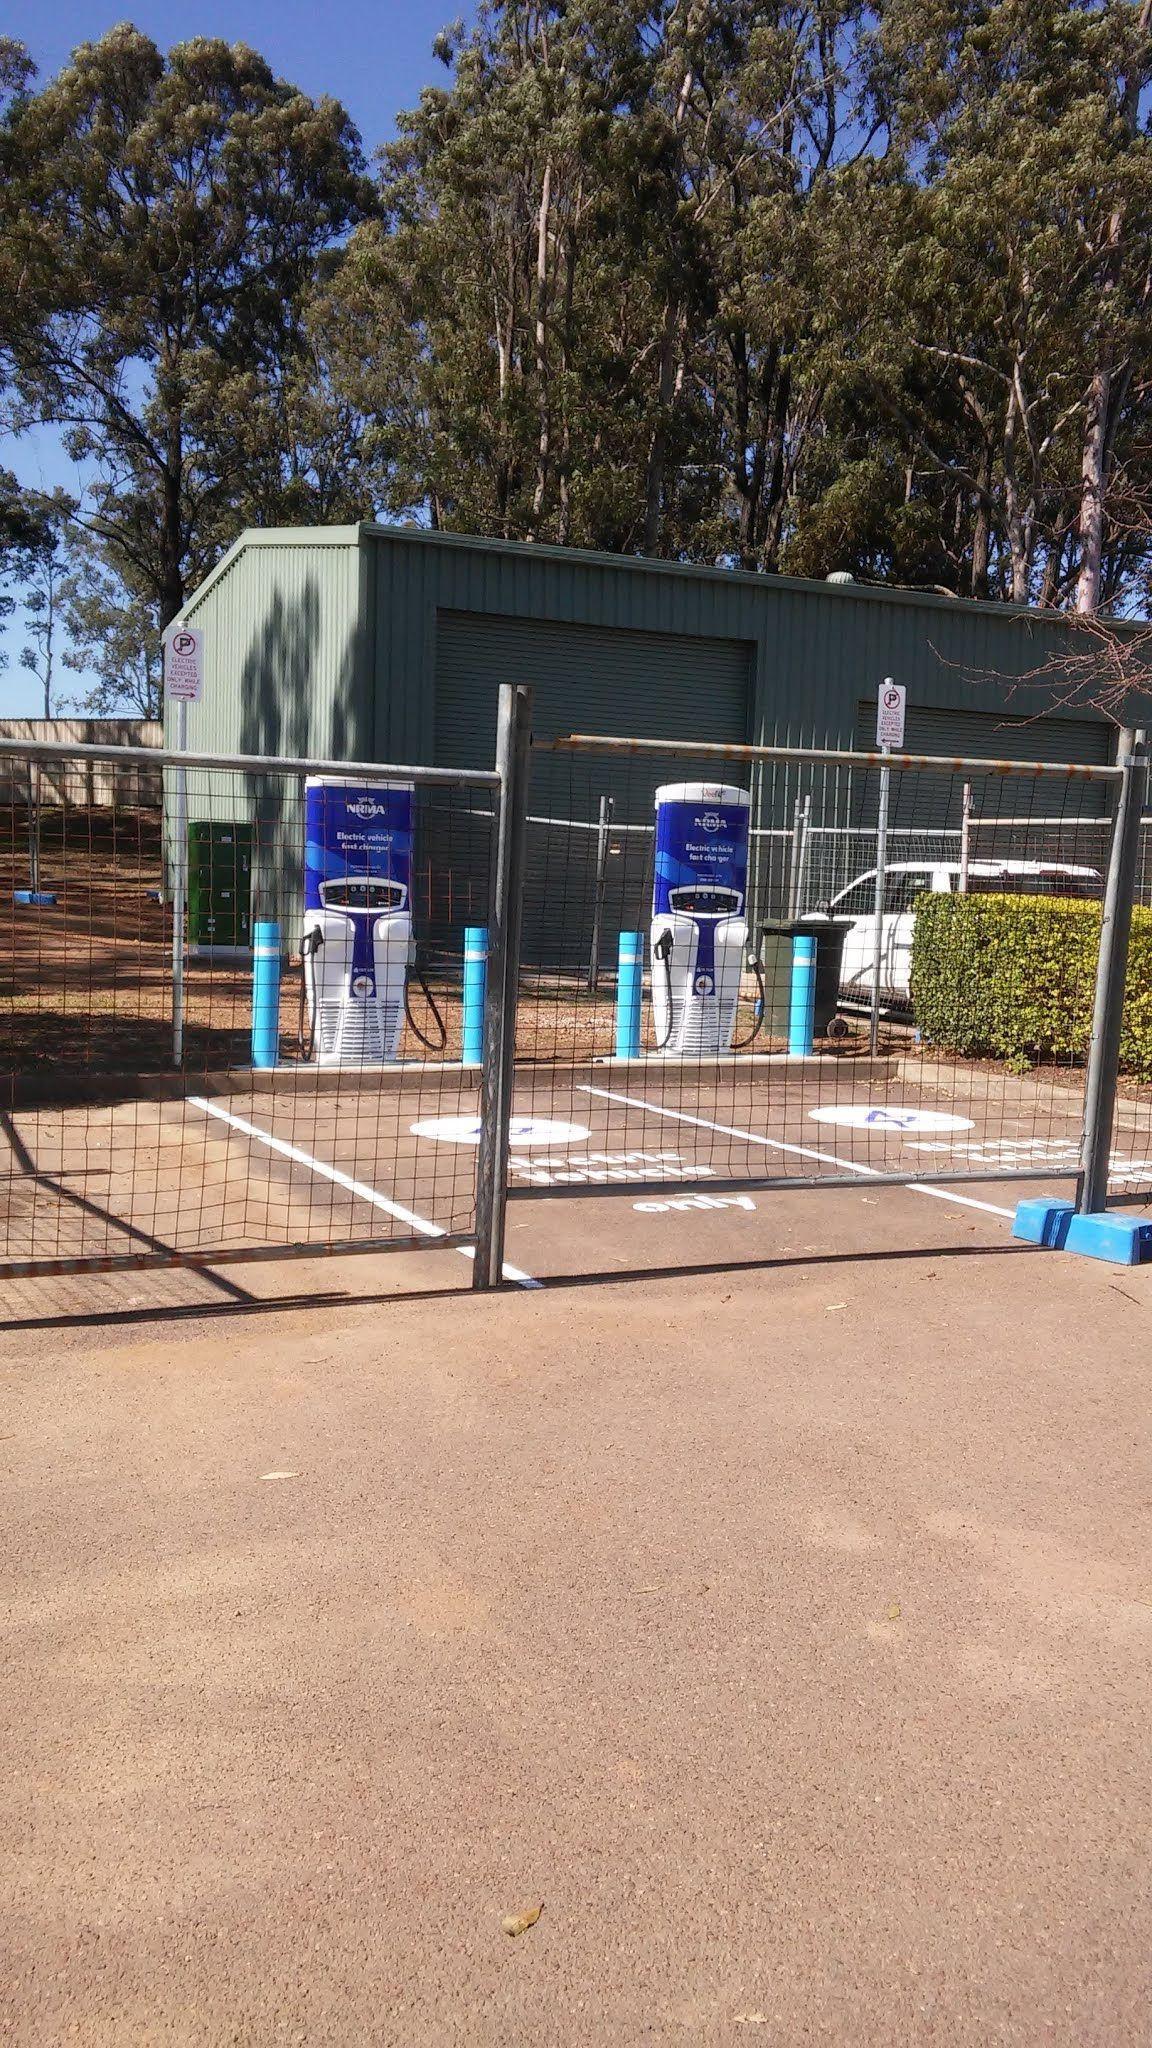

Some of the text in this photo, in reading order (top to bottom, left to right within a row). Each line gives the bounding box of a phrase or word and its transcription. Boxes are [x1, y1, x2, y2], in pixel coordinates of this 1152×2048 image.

[171, 657, 196, 665] ELECTRIC
[346, 804, 386, 815] NRMA
[336, 831, 394, 843] Electric vehicle
[685, 843, 710, 852] Electric
[704, 853, 730, 864] chager
[631, 1195, 758, 1213] only
